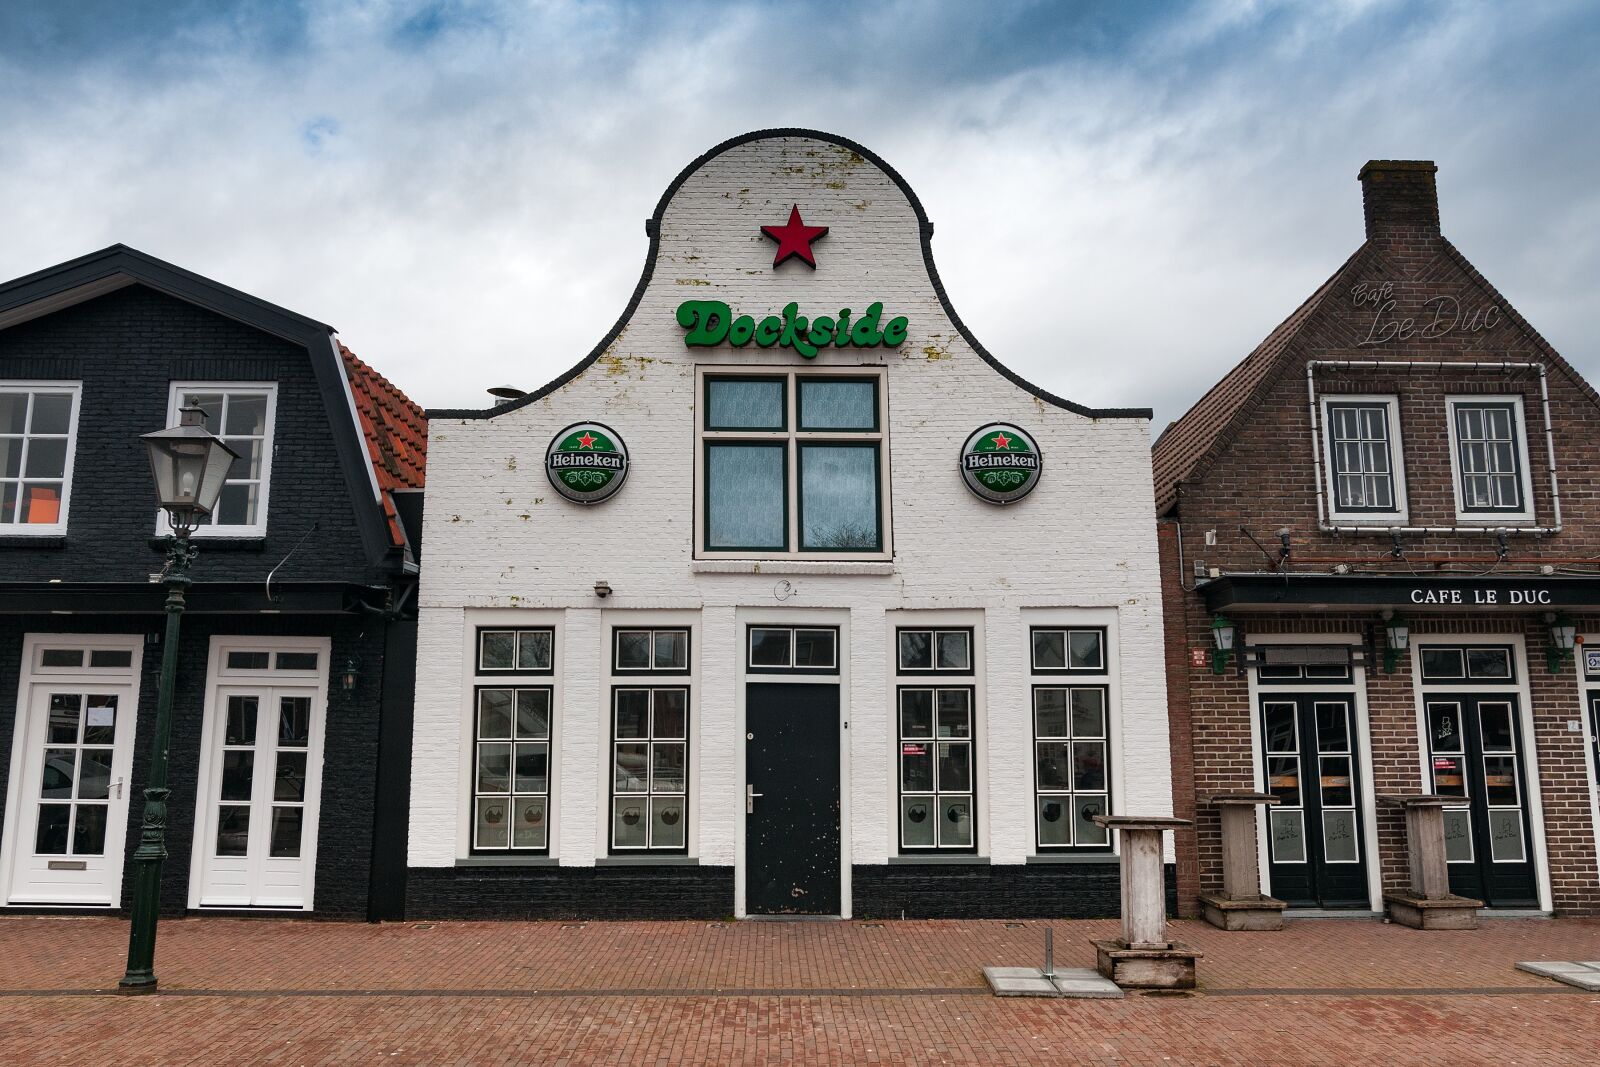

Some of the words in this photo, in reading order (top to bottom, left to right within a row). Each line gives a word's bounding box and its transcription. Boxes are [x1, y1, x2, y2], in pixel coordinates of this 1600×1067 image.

[1357, 300, 1417, 347] Le
[1421, 295, 1501, 339] Duc
[676, 300, 909, 360] Dockside
[552, 453, 621, 468] Heineken
[968, 453, 1036, 468] Heineken
[1410, 589, 1463, 605] CAFE
[1474, 589, 1498, 605] LE
[1509, 590, 1551, 605] DUC
